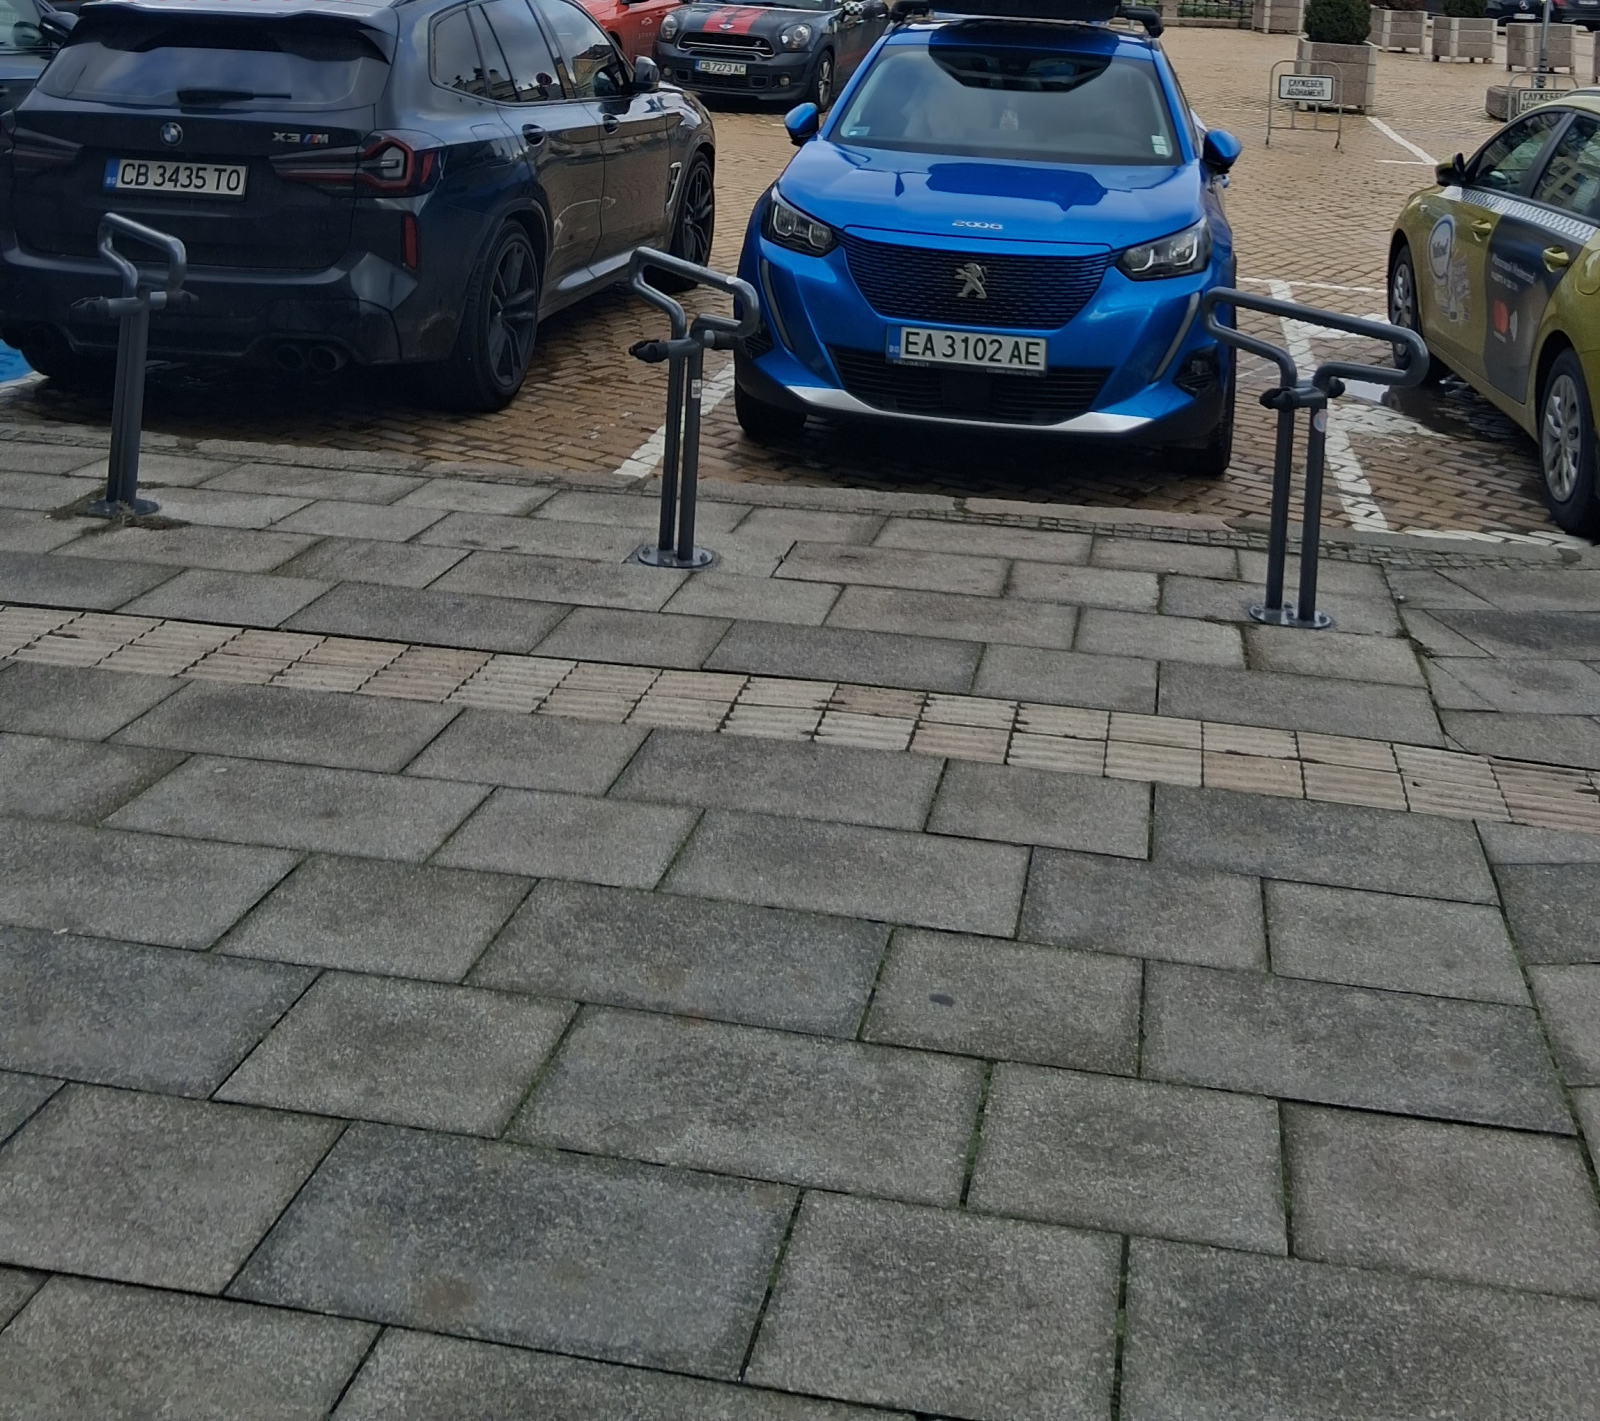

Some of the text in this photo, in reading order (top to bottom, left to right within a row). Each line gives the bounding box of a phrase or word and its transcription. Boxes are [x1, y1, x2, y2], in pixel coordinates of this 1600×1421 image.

[712, 62, 732, 73] 7273
[733, 64, 745, 74] AC
[1288, 79, 1324, 88] СЛУЖЕБЕН
[1286, 87, 1325, 97] АБОНАМЕНТ
[272, 131, 301, 142] X3
[120, 162, 150, 186] CB
[153, 164, 208, 189] 3435
[952, 219, 1004, 230] 2008
[904, 330, 1041, 366] EA 3102 AE
